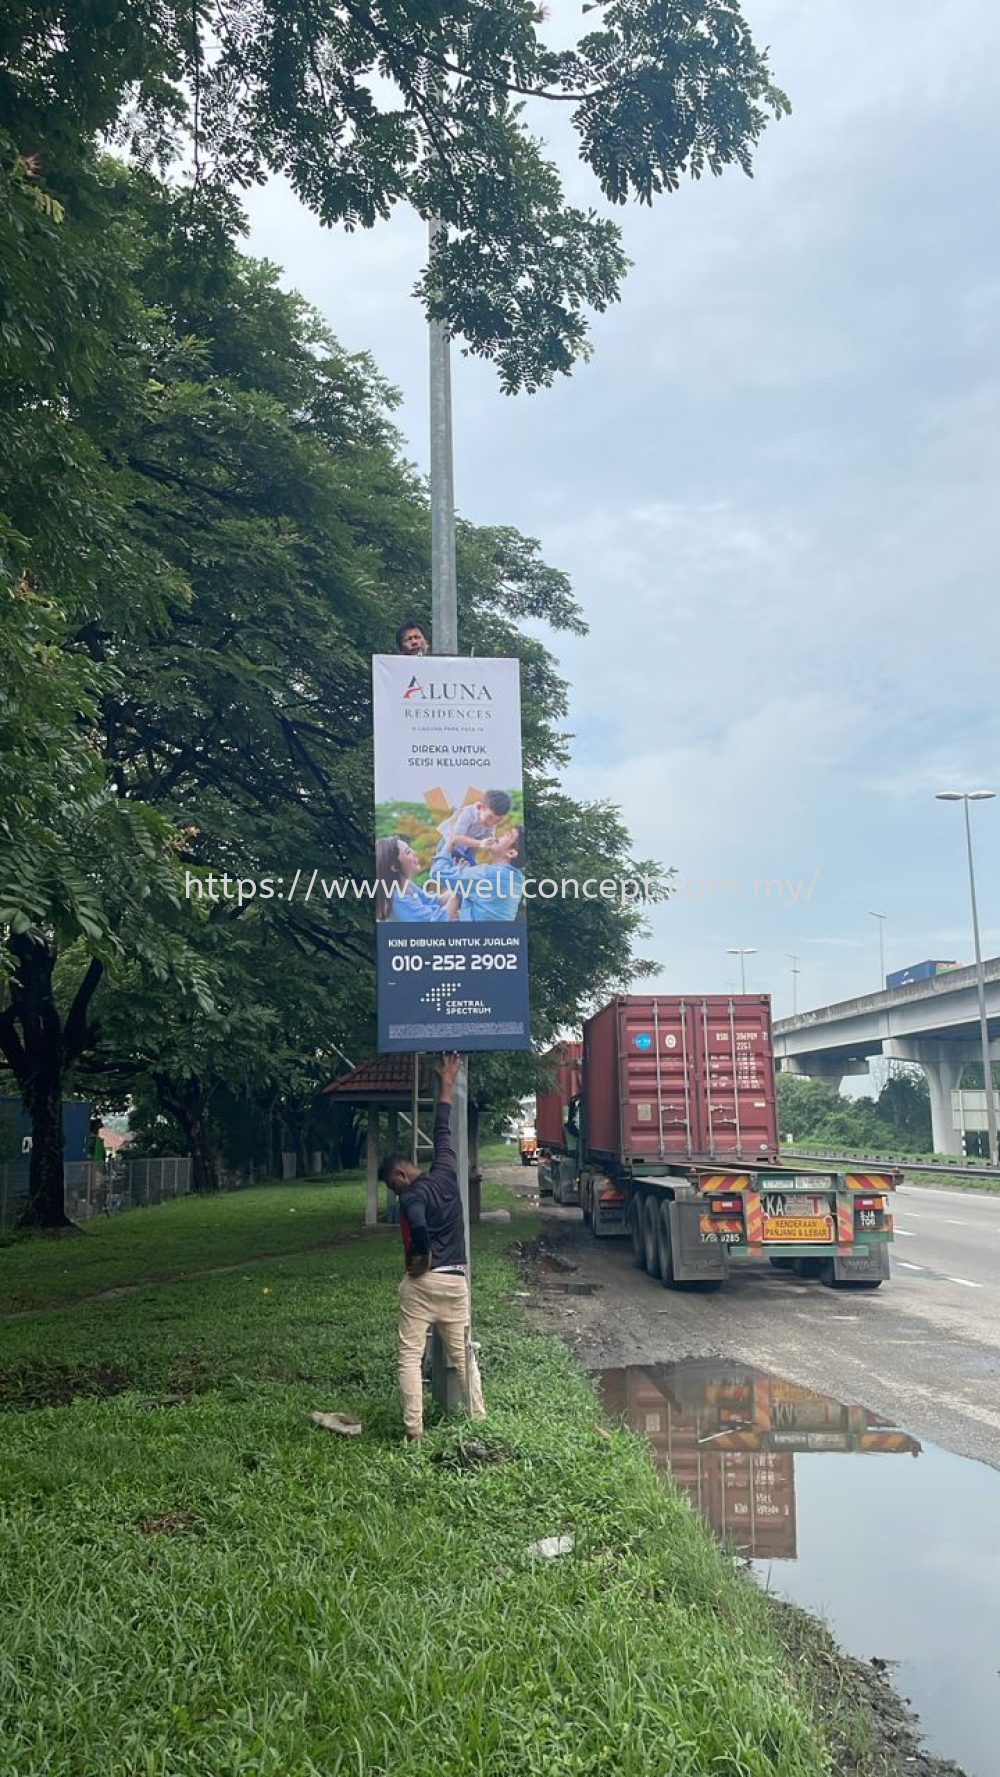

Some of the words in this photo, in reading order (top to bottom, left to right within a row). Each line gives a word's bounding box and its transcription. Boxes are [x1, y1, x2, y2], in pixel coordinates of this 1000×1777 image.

[402, 675, 493, 701] ALUNA
[404, 708, 492, 719] RESIDENCES
[411, 745, 449, 754] DIREKA
[451, 745, 487, 754] UNTUK
[407, 757, 434, 767] SEISI
[436, 757, 491, 767] KELUARGA
[388, 938, 408, 948] KINI
[409, 938, 446, 948] DIBUKA
[448, 937, 481, 947] UNTUK
[482, 937, 520, 946] JUALAN
[391, 954, 466, 972] 010-252
[470, 953, 518, 970] 2902
[445, 1007, 491, 1015] SPECTRUM
[774, 1219, 818, 1228] KENDERAAN
[766, 1228, 797, 1237] PANJANG
[803, 1228, 828, 1237] LEBAR
